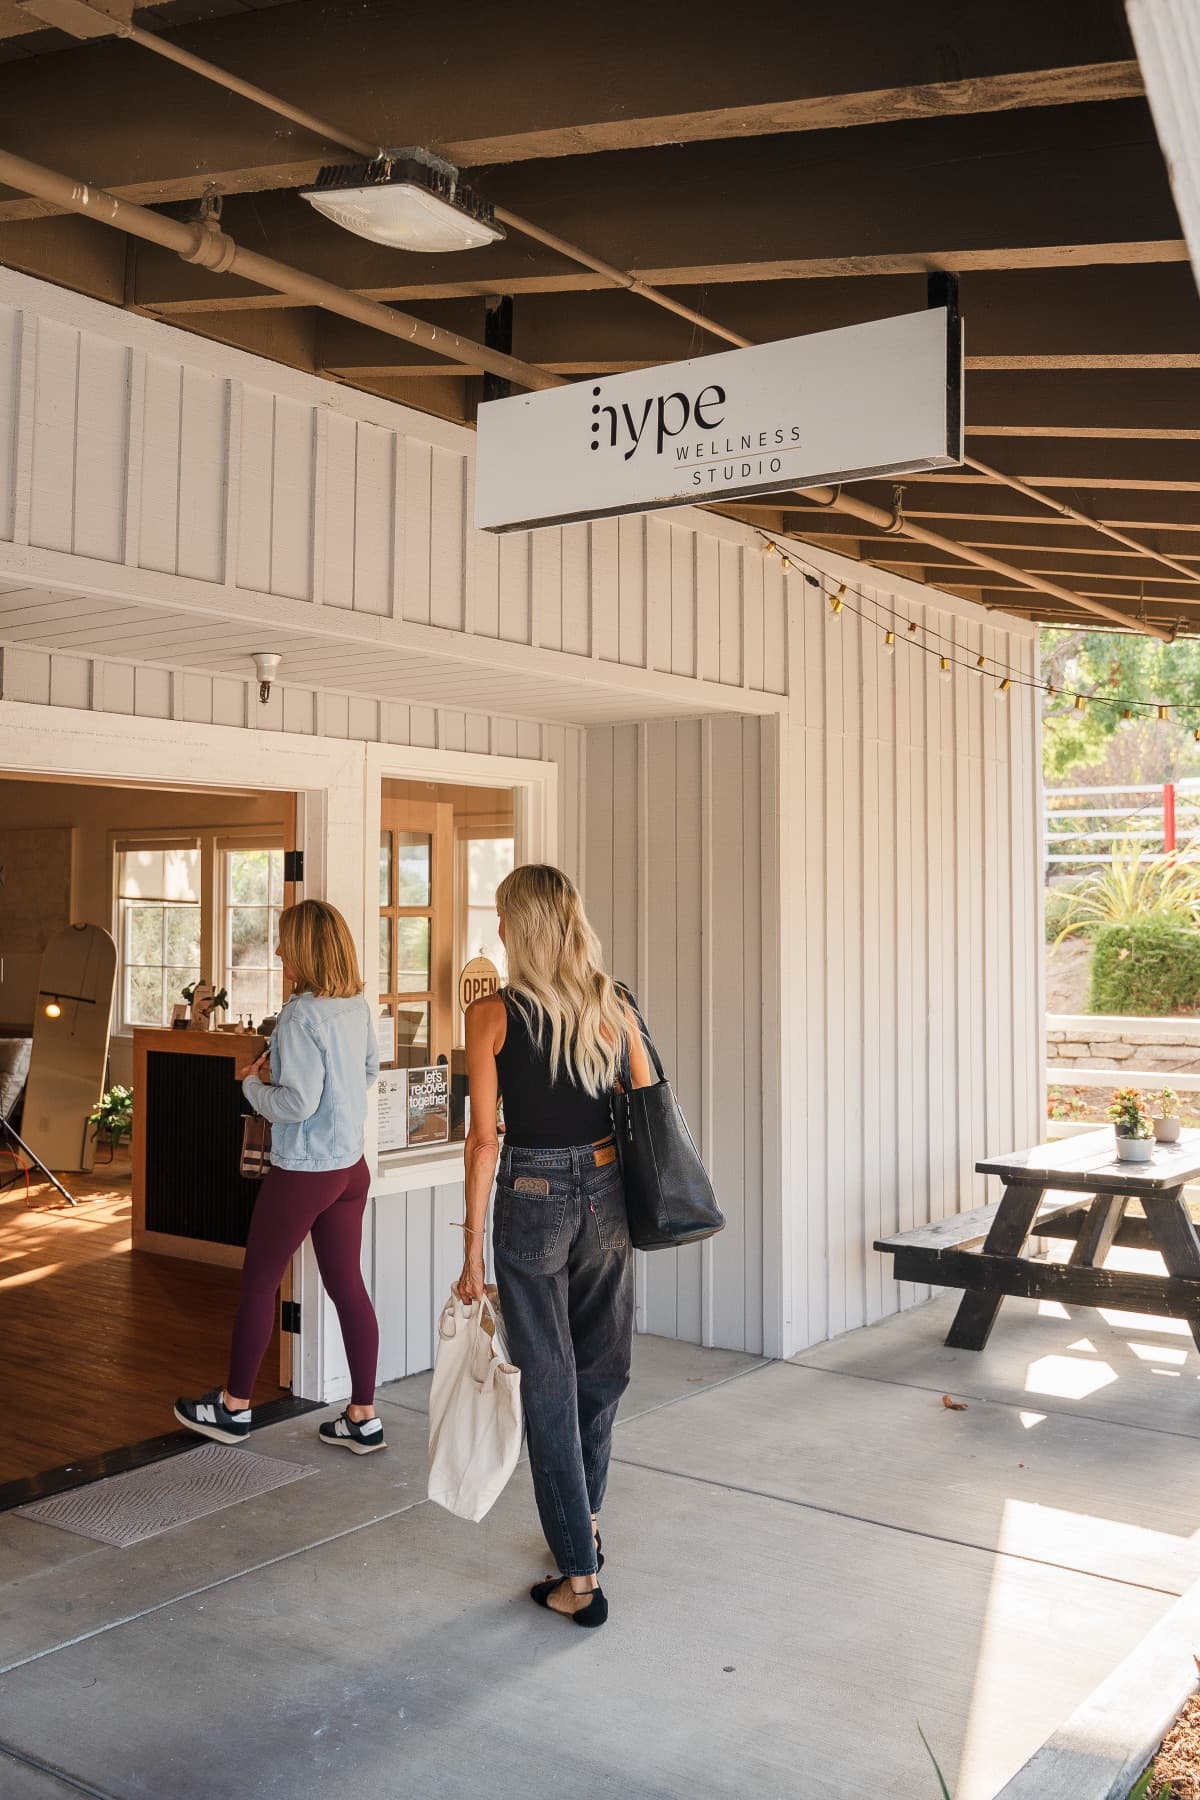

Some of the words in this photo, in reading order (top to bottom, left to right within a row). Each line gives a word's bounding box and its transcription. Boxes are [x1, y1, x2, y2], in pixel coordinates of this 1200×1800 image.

[591, 385, 726, 460] hype
[676, 427, 800, 460] WELLNESS
[692, 458, 781, 485] STUDIO
[464, 978, 497, 1004] OPEN
[409, 1093, 447, 1110] together
[411, 1081, 447, 1096] recover
